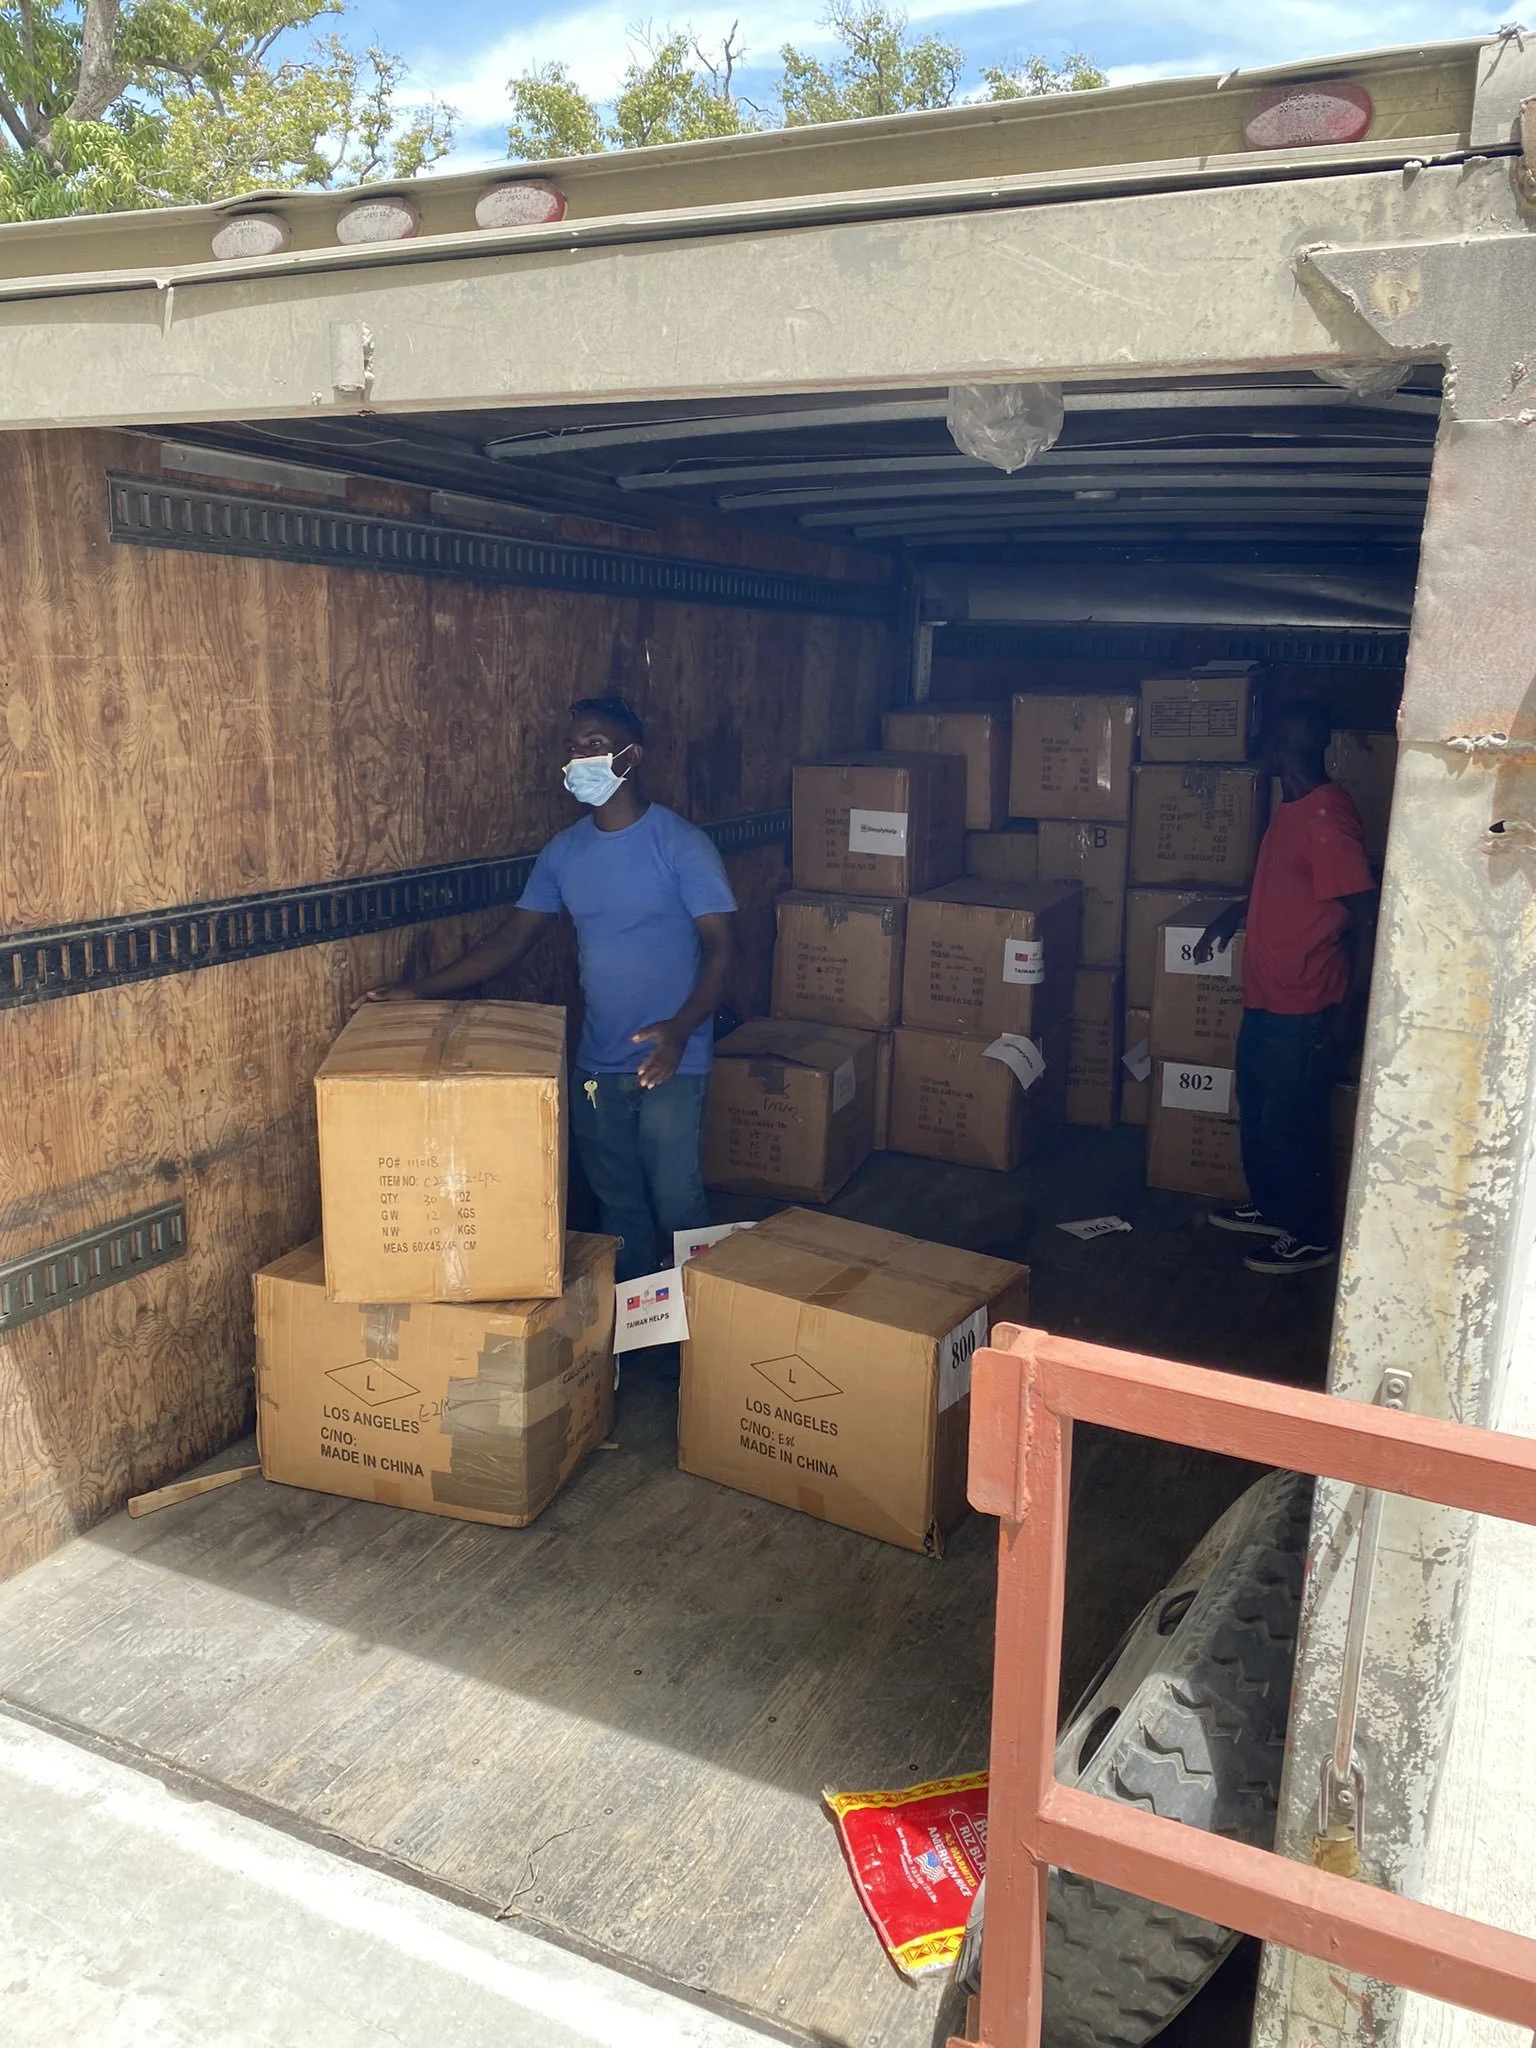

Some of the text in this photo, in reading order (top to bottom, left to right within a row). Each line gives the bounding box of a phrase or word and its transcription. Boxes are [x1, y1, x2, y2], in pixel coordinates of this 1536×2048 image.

[1094, 827, 1108, 849] B
[1181, 944, 1214, 961] 83
[1179, 1072, 1213, 1091] 802
[378, 1156, 400, 1169] PO#
[379, 1175, 401, 1187] ITEM
[457, 1208, 476, 1219] KGS
[457, 1224, 477, 1236] KGS
[383, 1242, 409, 1254] MEAS
[463, 1241, 477, 1252] CM
[626, 1311, 670, 1330] TAIWAN HELPS
[951, 1329, 976, 1369] 800
[366, 1375, 376, 1392] L
[788, 1368, 797, 1384] L
[323, 1404, 420, 1434] LOS ANGELES
[745, 1397, 839, 1437] LOS ANGELES
[320, 1443, 424, 1478] MADE IN CHINA
[740, 1434, 839, 1479] MADE IN CHINA
[959, 1825, 976, 1847] RIZ
[927, 1826, 973, 1897] AMERICAN RICE
[950, 1846, 978, 1888] MARMITES
